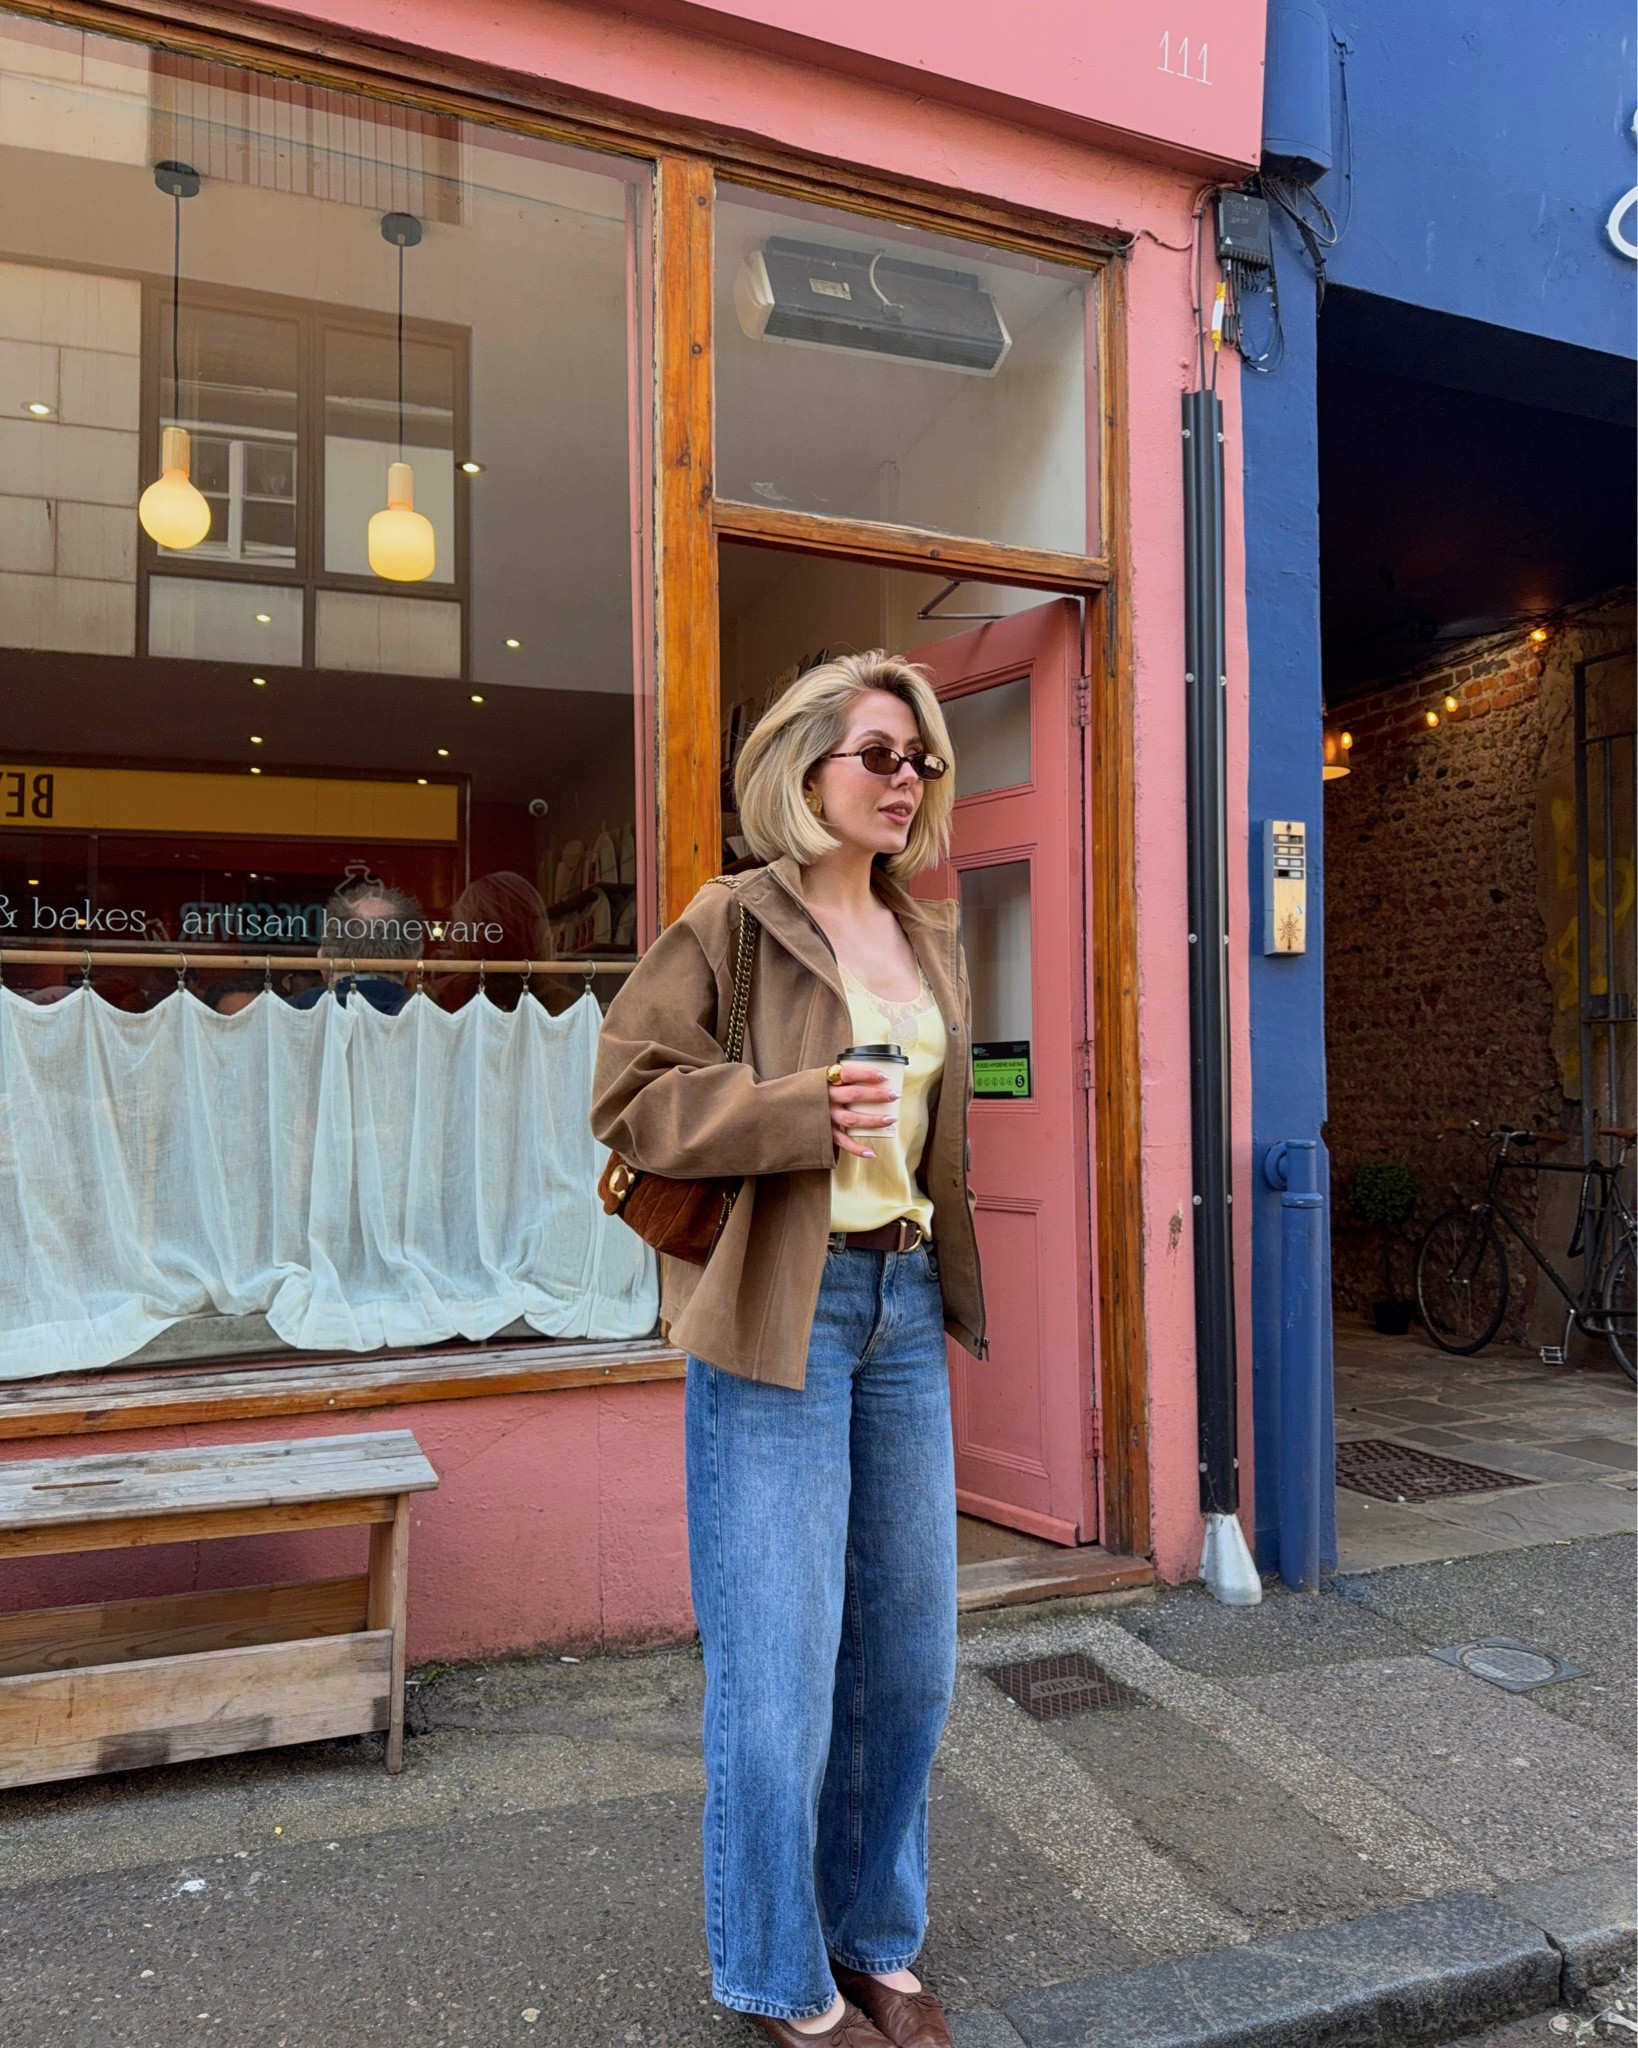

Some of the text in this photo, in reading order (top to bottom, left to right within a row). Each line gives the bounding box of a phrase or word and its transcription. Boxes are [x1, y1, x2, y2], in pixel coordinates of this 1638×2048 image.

[1157, 31, 1213, 85] 111
[0, 894, 504, 943] & bakes artisan homeware
[1035, 1677, 1090, 1694] WATER
